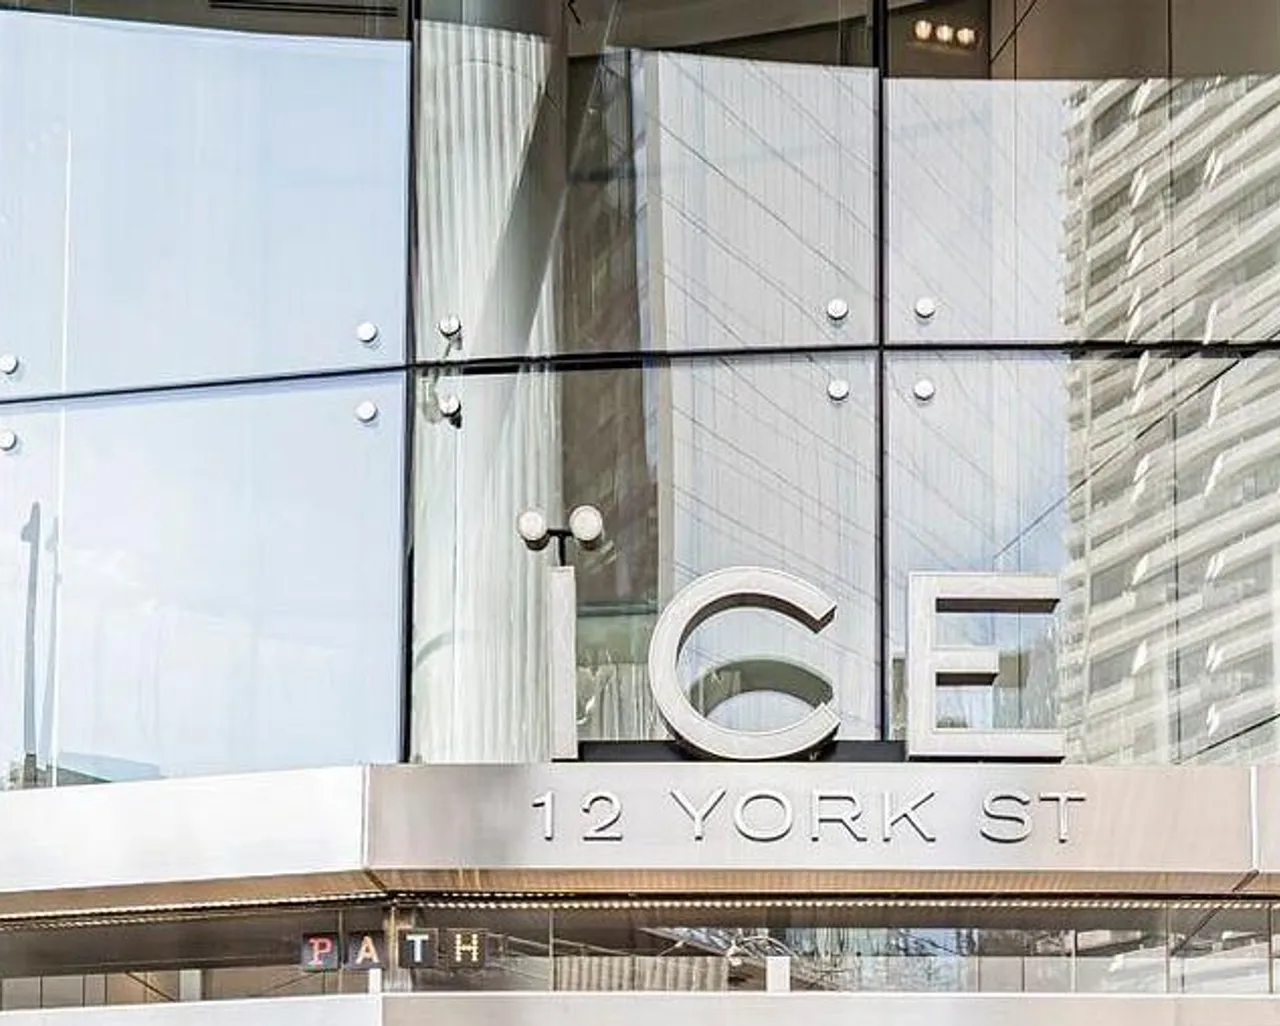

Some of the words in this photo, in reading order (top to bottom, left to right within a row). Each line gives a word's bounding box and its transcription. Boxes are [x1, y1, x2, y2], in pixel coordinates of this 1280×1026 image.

[549, 566, 1065, 762] ICE
[531, 790, 625, 844] 12
[670, 789, 937, 844] YORK
[978, 789, 1087, 844] ST
[307, 932, 479, 966] PATH
